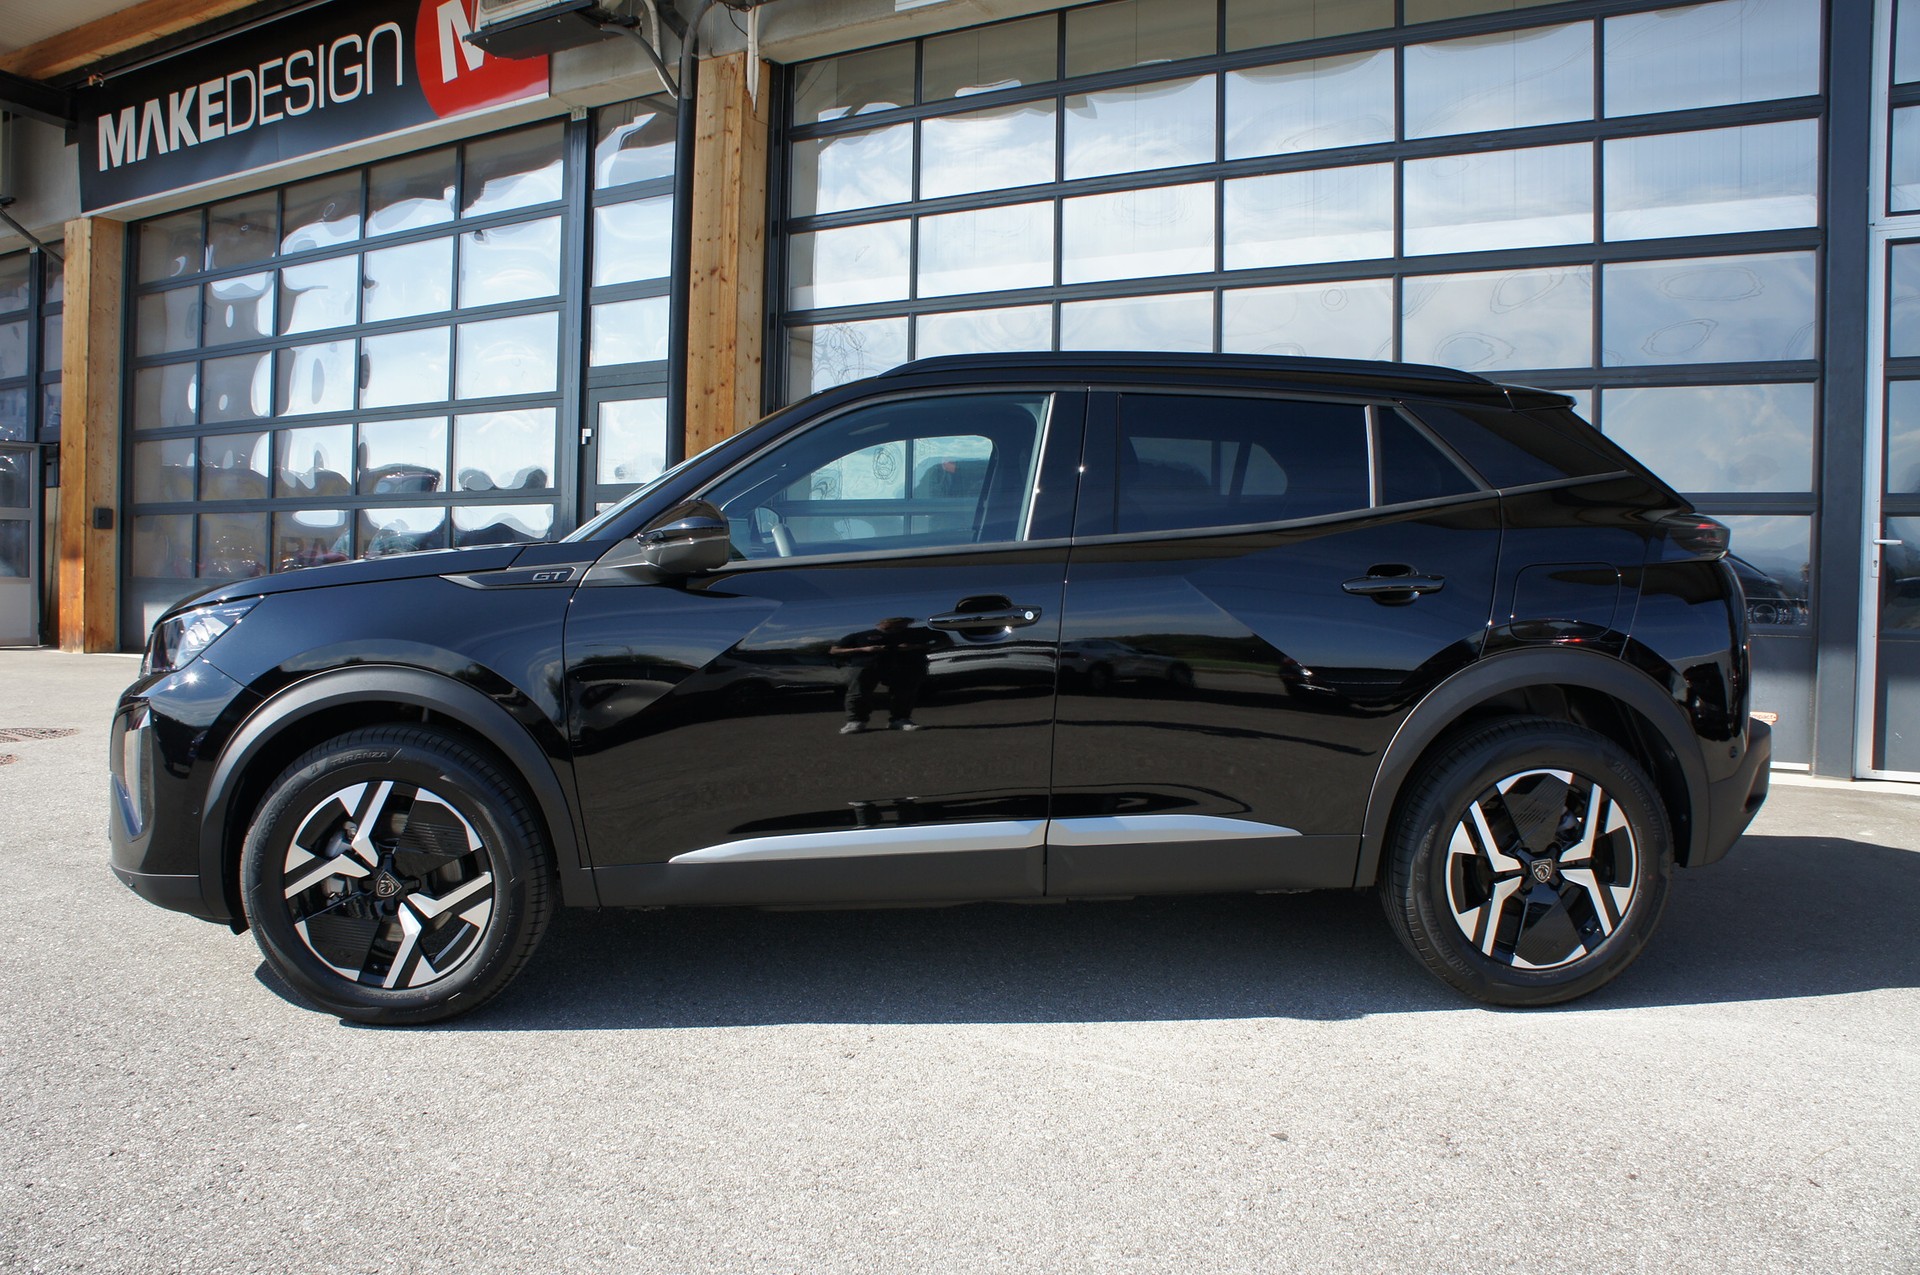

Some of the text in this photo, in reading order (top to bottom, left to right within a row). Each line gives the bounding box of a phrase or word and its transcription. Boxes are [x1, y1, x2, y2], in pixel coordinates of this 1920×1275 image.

[98, 21, 403, 172] MAKEDESIGN
[532, 571, 567, 581] GT
[329, 751, 388, 766] TURANZA
